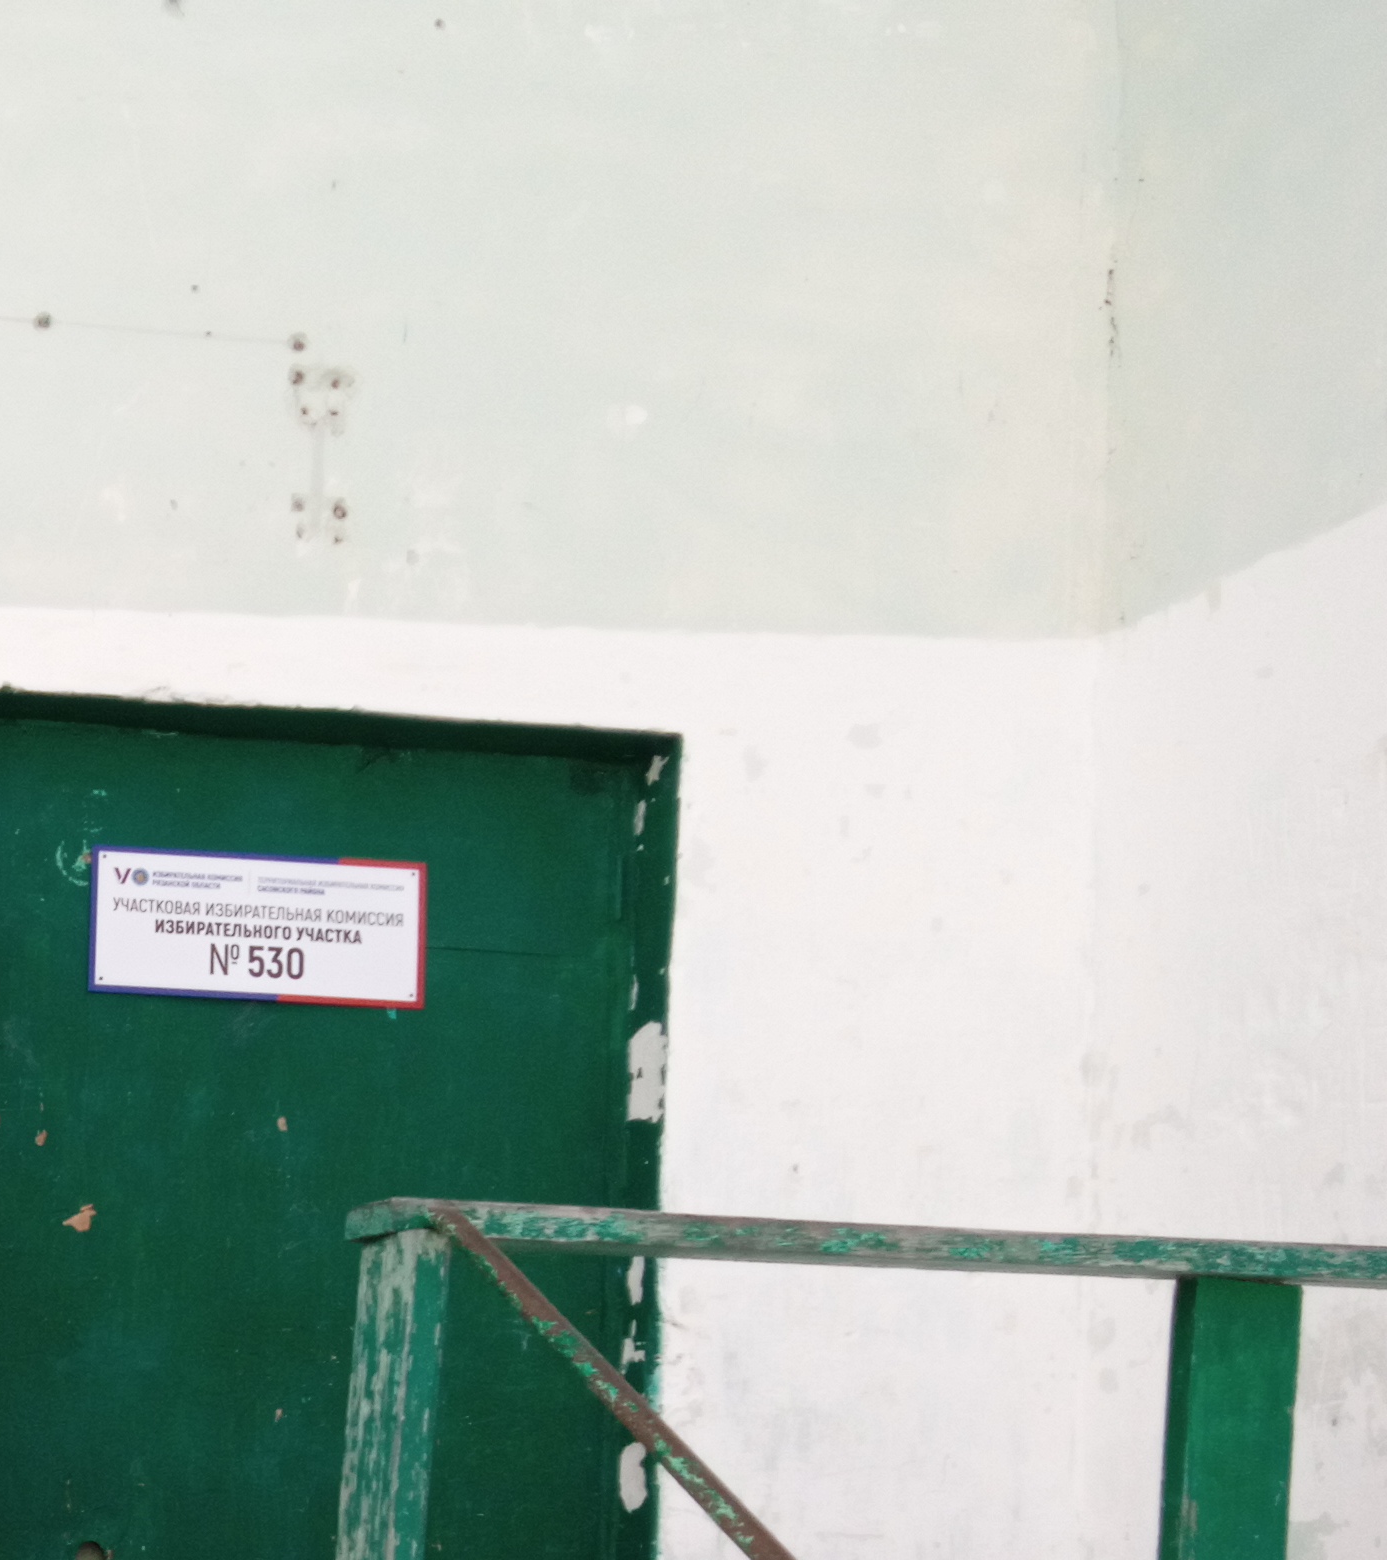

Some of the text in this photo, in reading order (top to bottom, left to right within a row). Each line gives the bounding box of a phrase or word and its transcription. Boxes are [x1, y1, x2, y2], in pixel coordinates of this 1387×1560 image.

[113, 897, 405, 927] УЧАСТКОВАЯ ИЗБИРАТЕЛЬНАЯ КОМИССИЯ
[155, 919, 362, 944] ИЗБИРАТЕЛЬНОГО УЧАСТКА
[248, 945, 304, 979] 530
